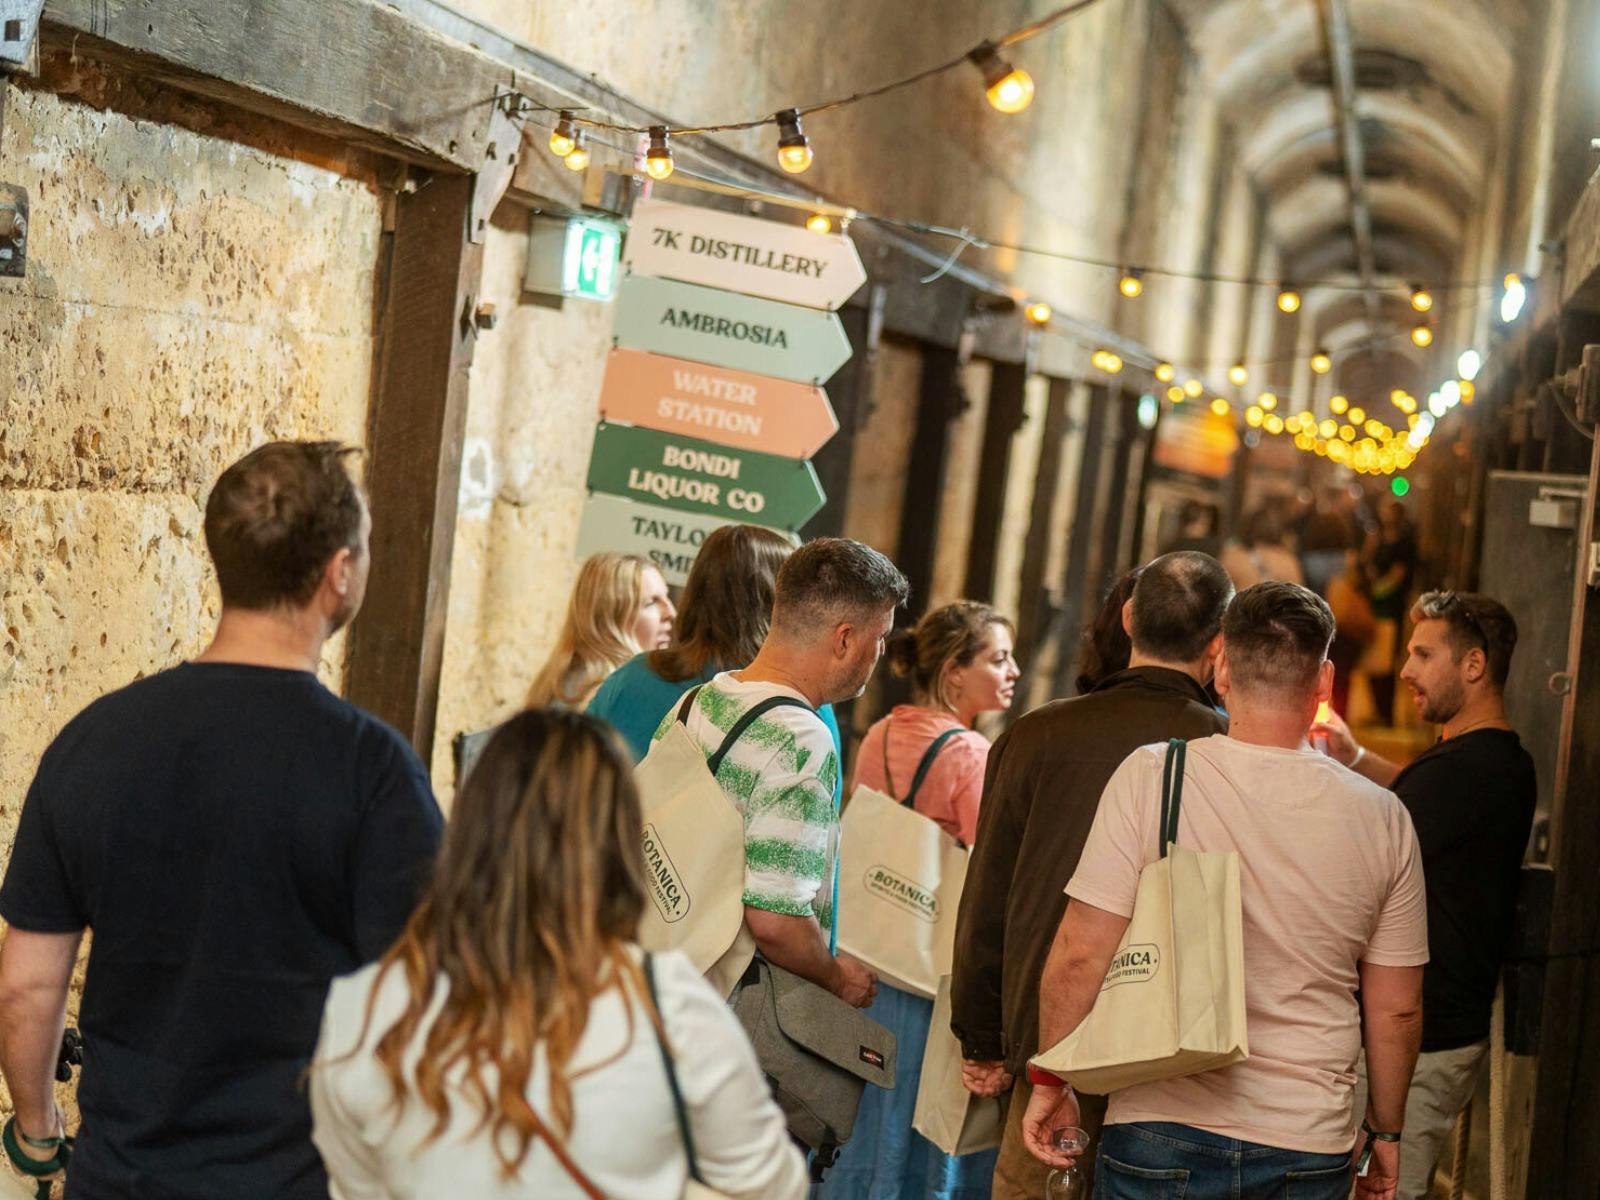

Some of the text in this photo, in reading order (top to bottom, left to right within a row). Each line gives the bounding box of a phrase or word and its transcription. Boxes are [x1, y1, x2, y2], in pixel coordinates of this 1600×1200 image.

[652, 227, 828, 279] 7K DISTILLERY
[660, 307, 788, 349] AMBROSIA
[672, 368, 758, 406] WATER
[656, 396, 764, 437] STATION
[662, 444, 741, 480] BONDI
[627, 466, 765, 514] LIQUOR CO
[632, 516, 707, 548] TAYLO
[648, 549, 694, 574] SMI
[873, 870, 937, 913] BOTANICA
